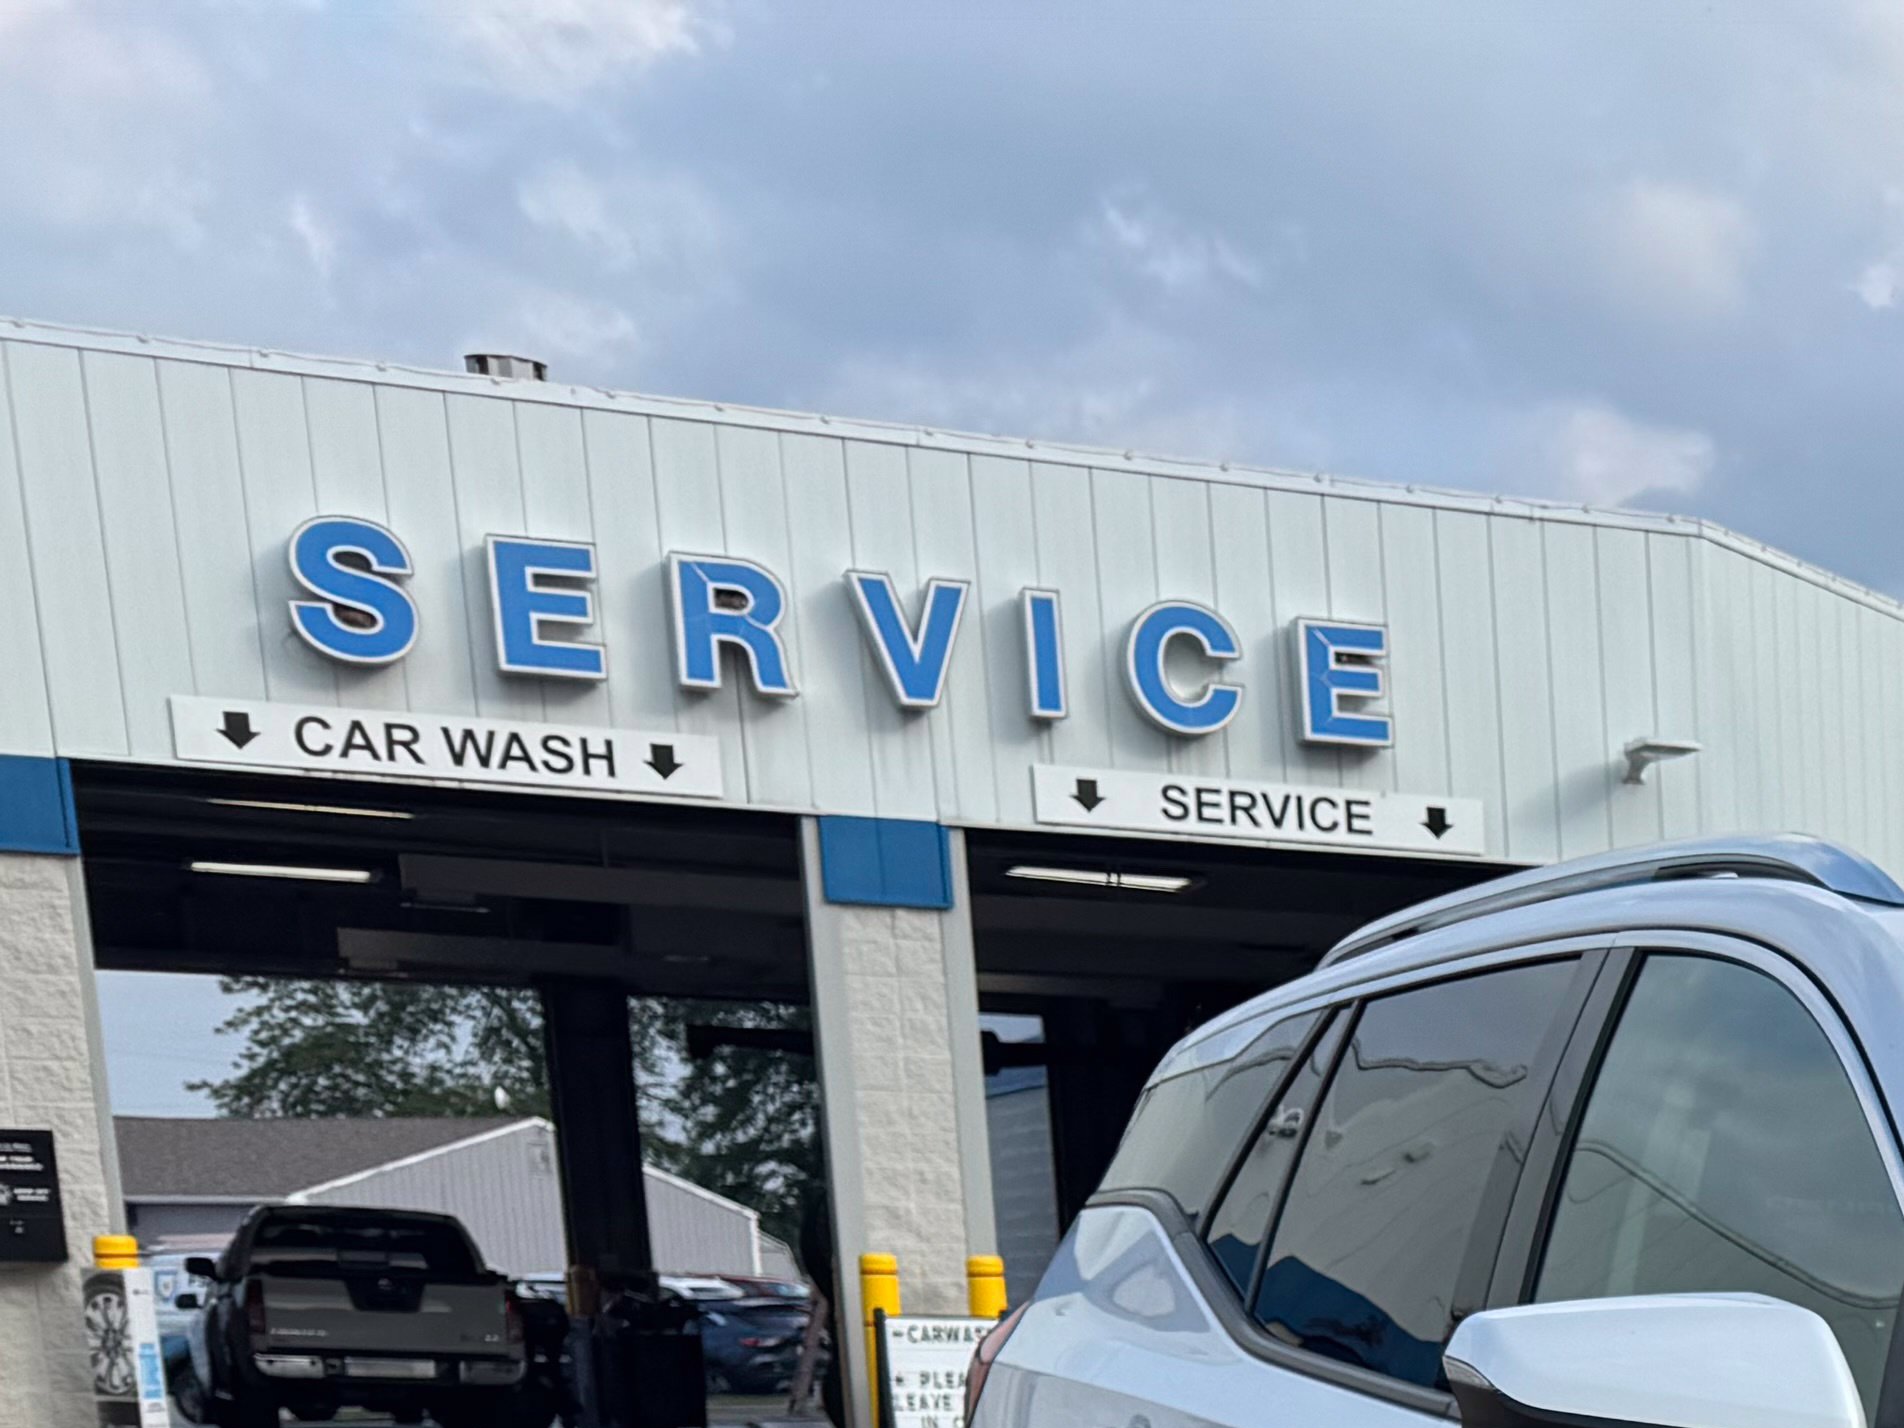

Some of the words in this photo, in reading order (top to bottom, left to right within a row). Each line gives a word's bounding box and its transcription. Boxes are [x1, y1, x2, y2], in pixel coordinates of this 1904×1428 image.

[288, 514, 1395, 748] SERVICE
[294, 715, 425, 766] CAR
[441, 725, 618, 779] WASH
[1160, 783, 1373, 836] SERVICE
[907, 1324, 993, 1343] CARWAS
